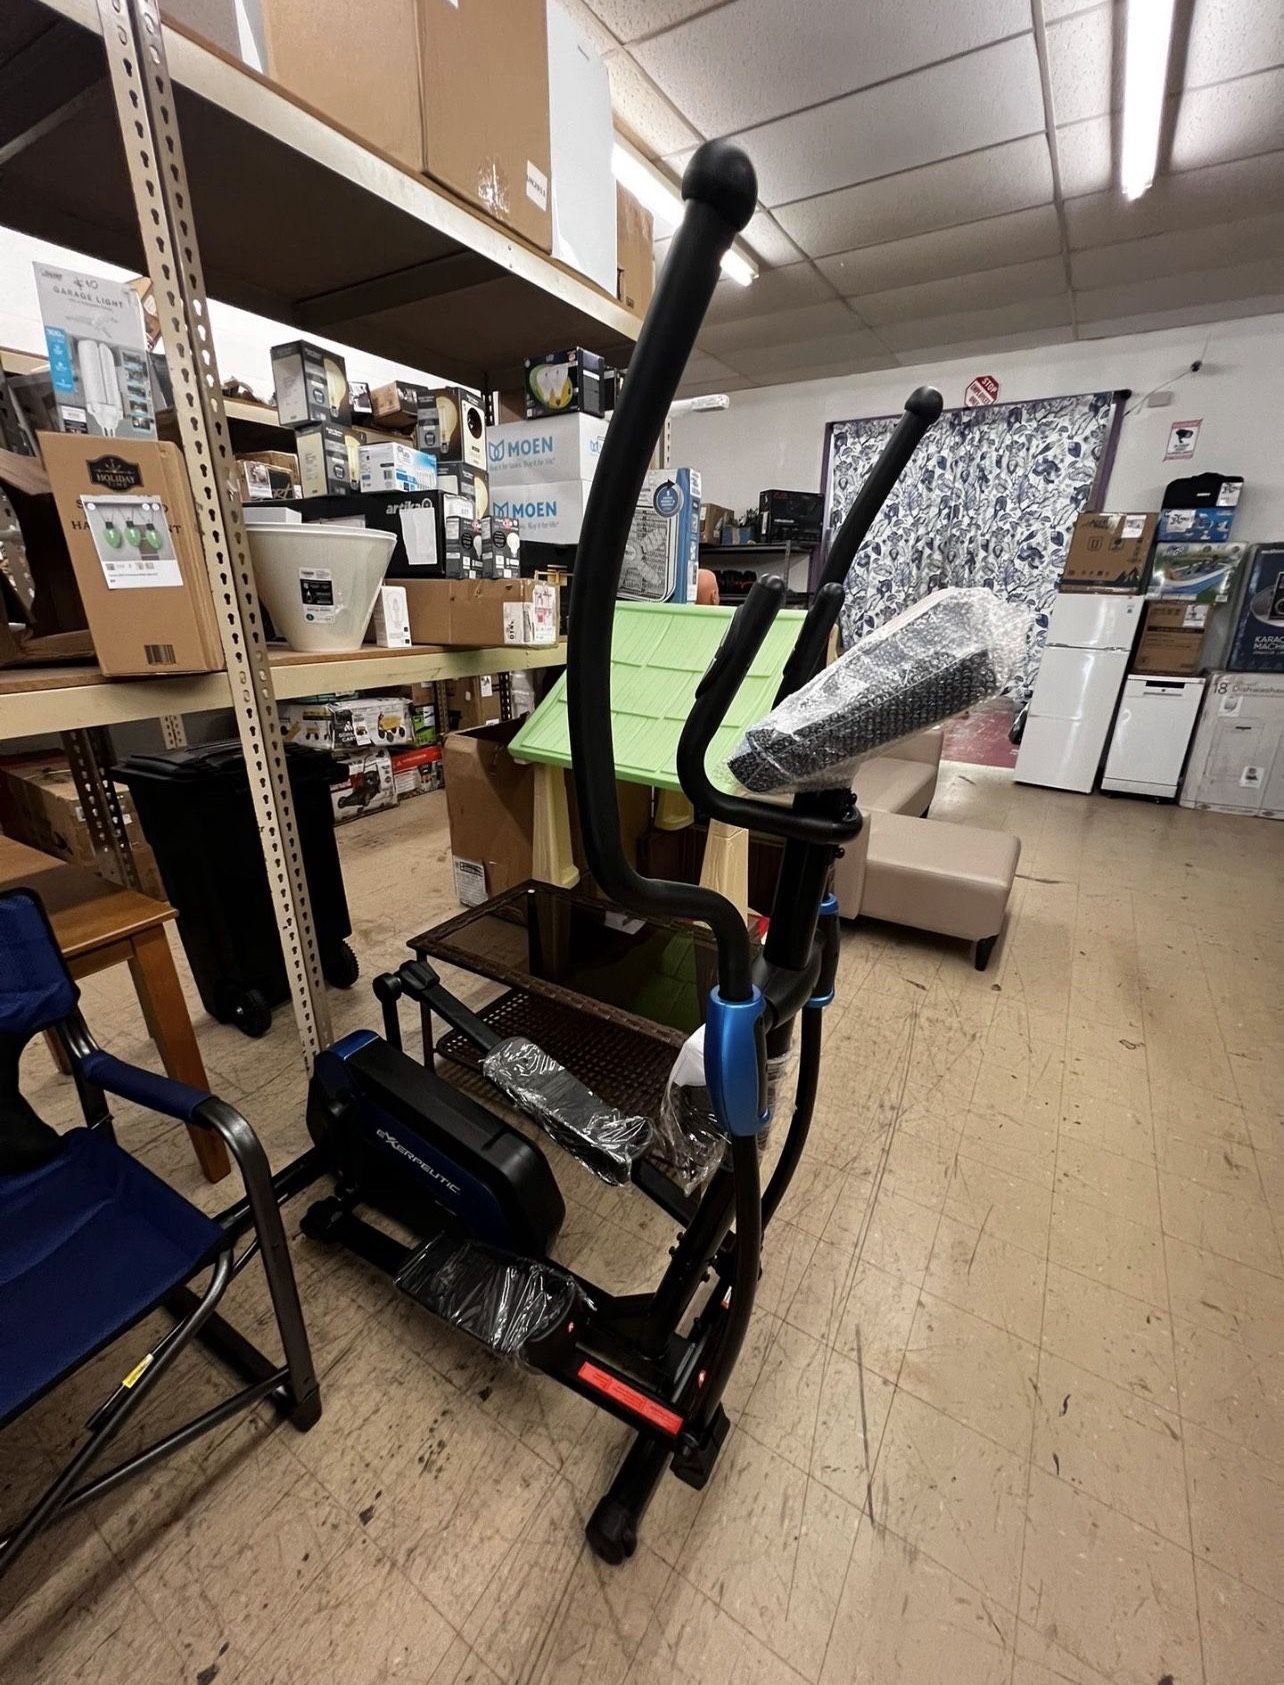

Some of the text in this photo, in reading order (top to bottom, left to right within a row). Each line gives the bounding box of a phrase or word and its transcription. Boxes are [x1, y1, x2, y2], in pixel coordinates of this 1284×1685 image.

[53, 286, 92, 301] GARAGE
[96, 296, 123, 308] LIGHT
[981, 378, 997, 392] STOP
[508, 436, 553, 457] MOEN
[96, 473, 136, 485] HOLIDAY
[512, 501, 557, 518] MOEN
